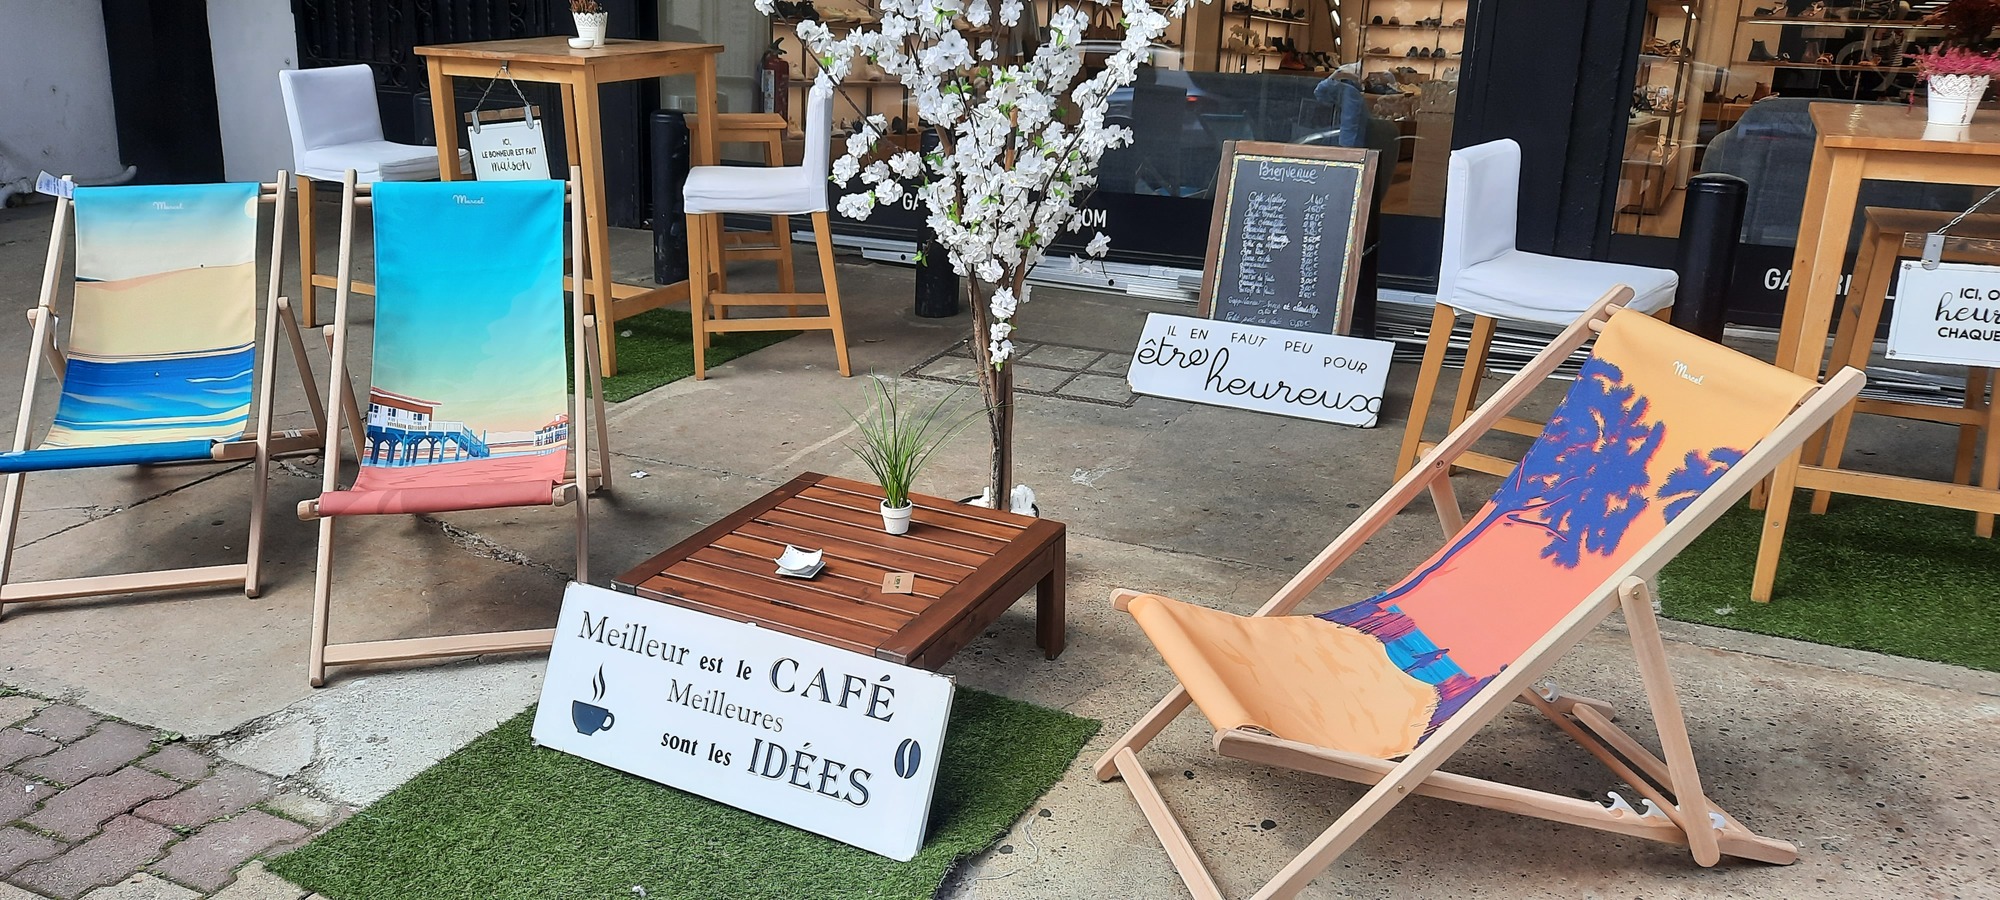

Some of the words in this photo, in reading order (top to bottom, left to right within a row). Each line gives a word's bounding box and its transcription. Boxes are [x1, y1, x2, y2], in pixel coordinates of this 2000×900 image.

[481, 151, 488, 159] LE
[488, 149, 514, 158] BONHEUR
[515, 148, 525, 156] EST
[525, 147, 537, 155] FAIT
[490, 158, 532, 172] maison
[452, 194, 485, 205] Marcel
[1959, 287, 1982, 302] ICI,
[1167, 325, 1178, 337] IL
[1190, 328, 1210, 341] EN
[1230, 331, 1268, 347] FAUT
[1284, 340, 1314, 354] PEU
[1323, 356, 1368, 375] POUR
[1137, 336, 1209, 369] être
[1204, 347, 1383, 415] heureux
[1672, 360, 1704, 386] Marcel
[577, 610, 690, 667] Meilleur
[699, 653, 723, 674] est
[735, 659, 752, 681] le
[768, 656, 896, 724] CAFÉ
[666, 678, 785, 734] Meilleures
[660, 730, 699, 758] sont
[707, 743, 733, 768] les
[746, 738, 873, 808] IDÉES
